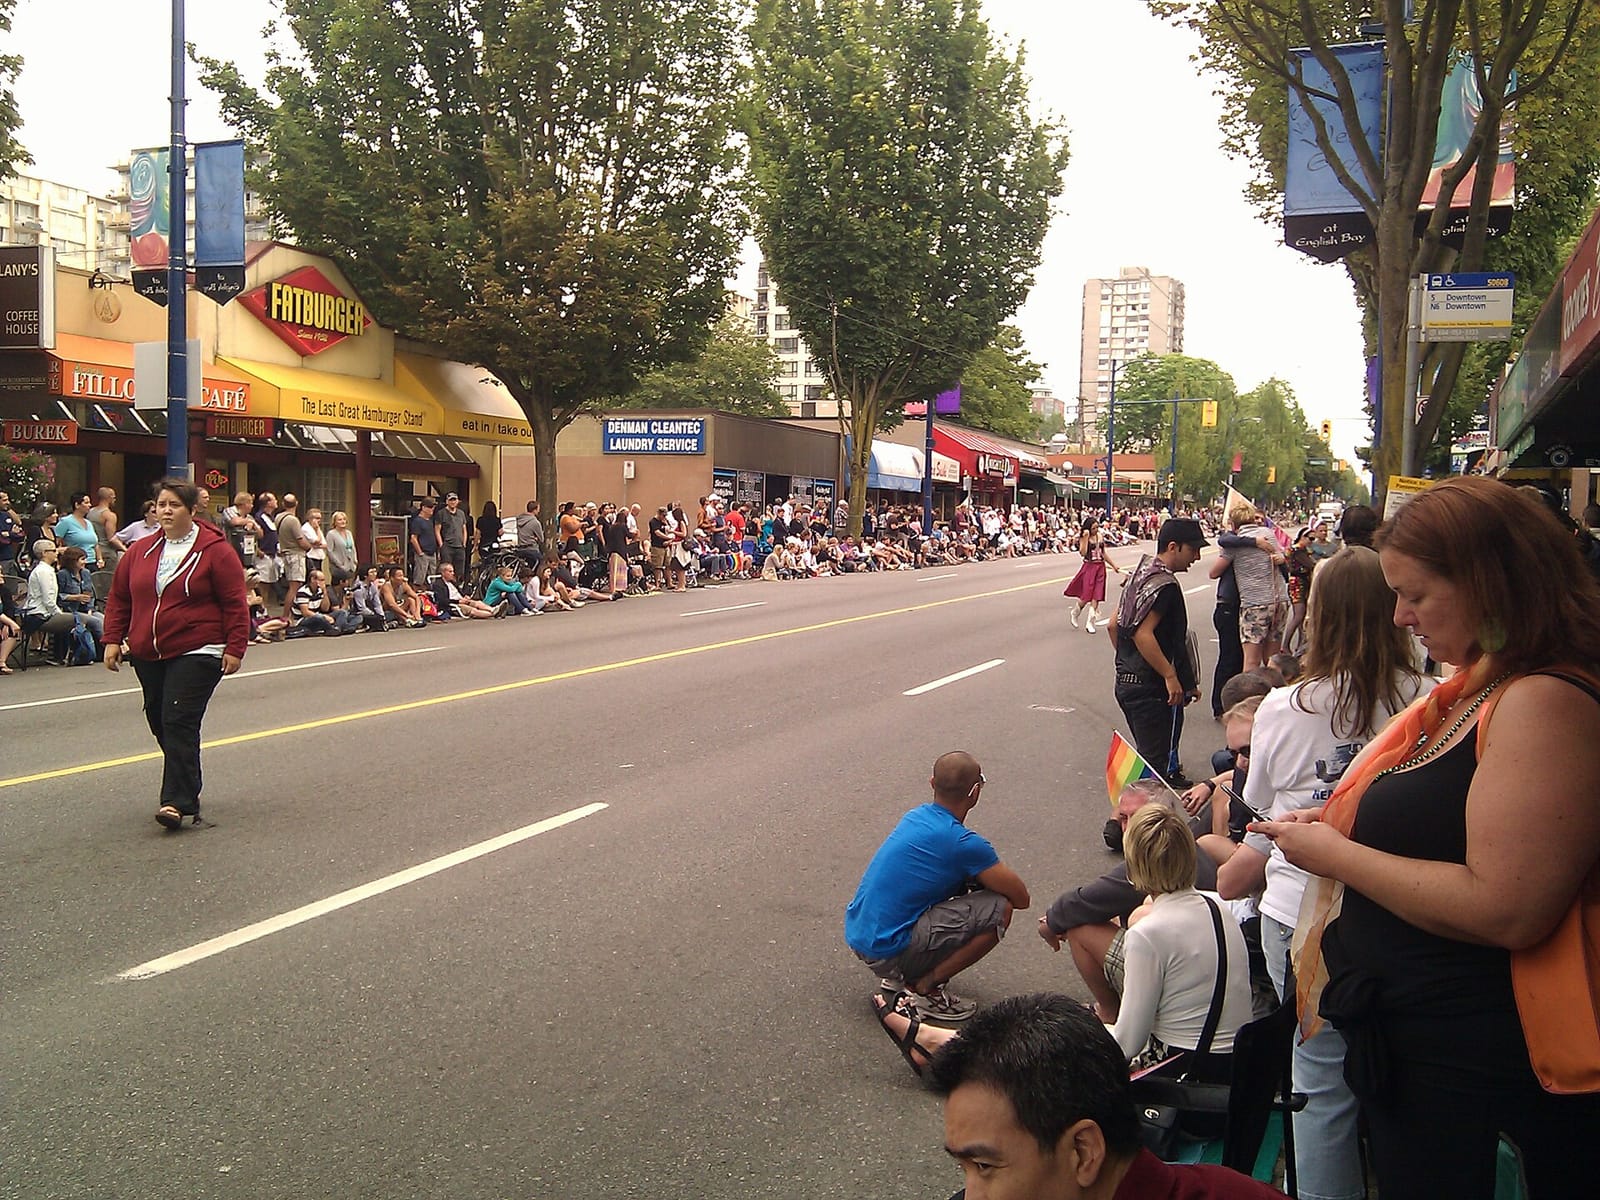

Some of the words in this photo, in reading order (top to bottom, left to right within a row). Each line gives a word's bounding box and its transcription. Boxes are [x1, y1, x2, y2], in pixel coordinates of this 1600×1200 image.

[1323, 223, 1338, 233] at
[1296, 236, 1338, 248] English
[1341, 232, 1366, 243] Bay
[6, 310, 38, 321] COFFEE
[272, 282, 364, 336] FATBURGER
[6, 324, 38, 334] HOUSE
[201, 387, 246, 410] CAFÉ
[301, 397, 315, 414] The
[319, 400, 336, 417] Last
[339, 402, 360, 420] Great
[362, 405, 401, 427] Hamburger
[404, 410, 423, 426] Stand
[12, 424, 68, 441] BUREK
[215, 420, 265, 435] FATBURGER
[462, 420, 478, 431] eat
[482, 420, 490, 432] in
[498, 424, 518, 436] take
[520, 428, 532, 437] ou
[608, 422, 648, 434] DENMAN
[651, 421, 700, 434] CLEANTEC
[609, 438, 654, 450] LAUNDRY
[656, 438, 698, 451] SERVICE
